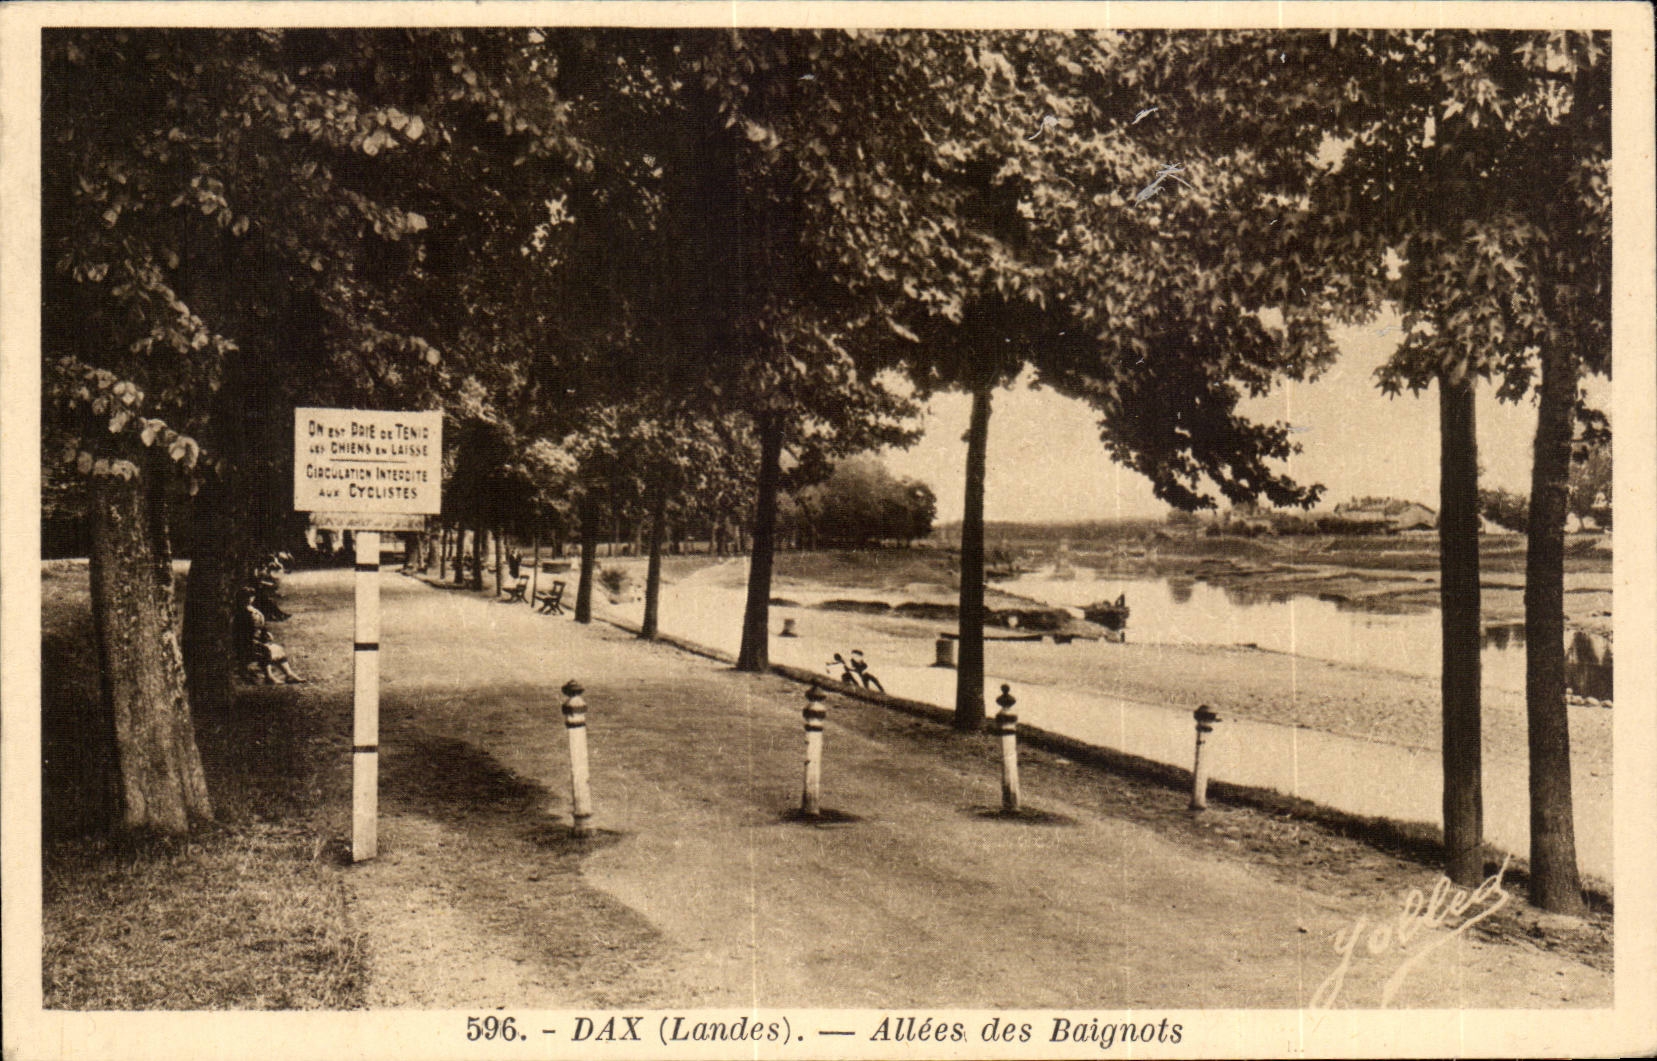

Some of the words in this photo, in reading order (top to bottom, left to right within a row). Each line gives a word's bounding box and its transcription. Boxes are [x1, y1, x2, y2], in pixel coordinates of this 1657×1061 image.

[308, 419, 324, 437] ON
[331, 441, 371, 455] CHIENS
[391, 444, 428, 456] LAISSE
[306, 463, 372, 481] CIRCULATION
[376, 467, 428, 482] INTERDITE
[319, 488, 340, 497] AUX
[349, 483, 418, 499] CYCLISTES
